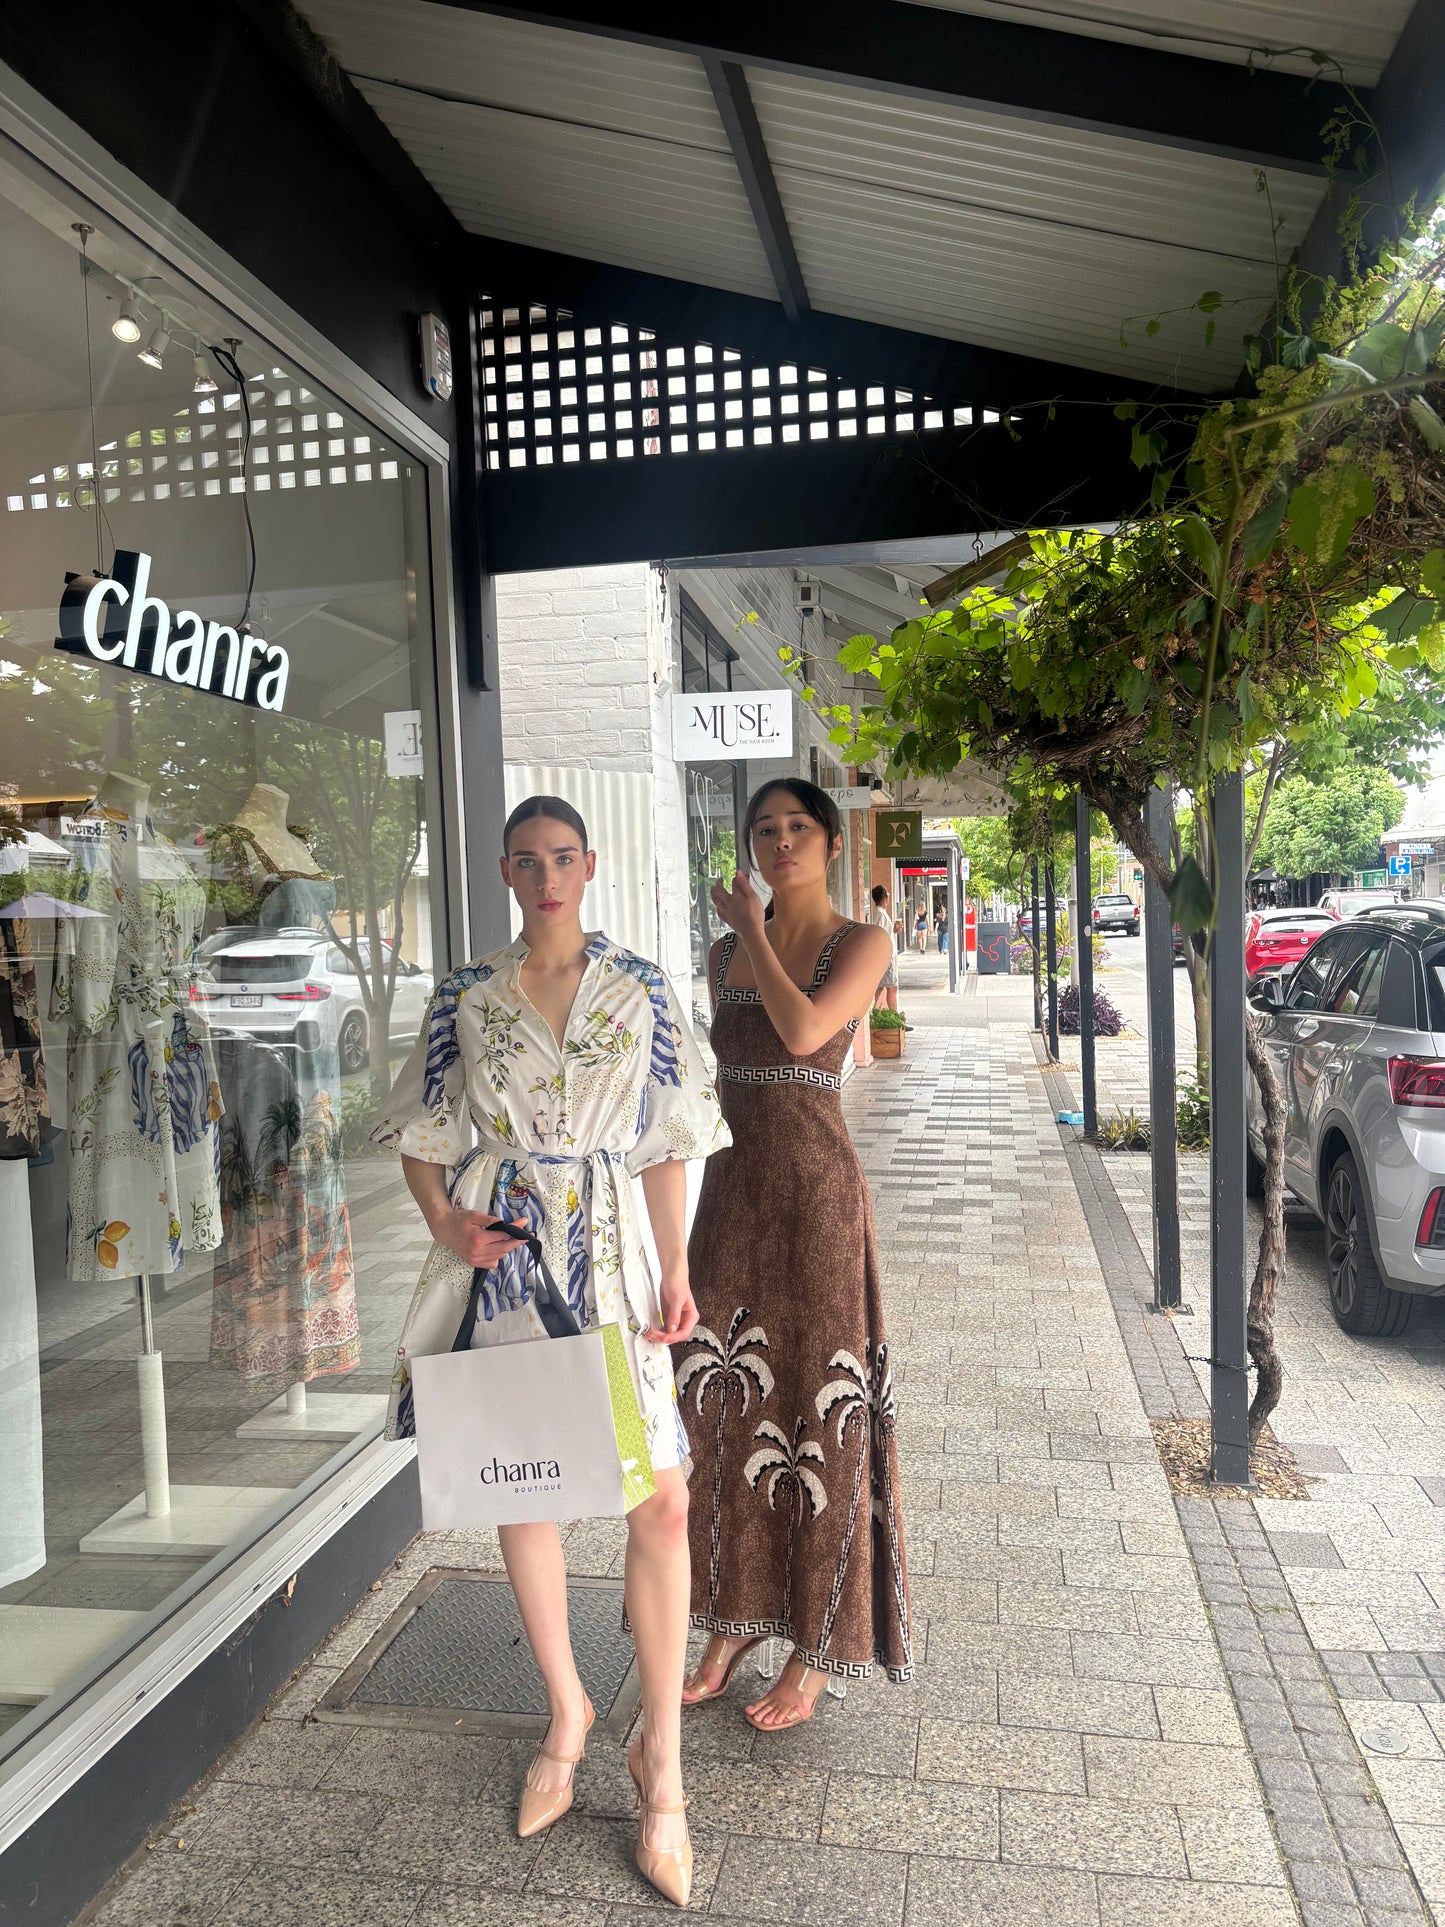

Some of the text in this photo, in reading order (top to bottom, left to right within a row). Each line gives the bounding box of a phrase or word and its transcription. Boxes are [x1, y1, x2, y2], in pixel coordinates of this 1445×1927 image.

[82, 552, 290, 712] chanra
[689, 703, 780, 747] MUSE.
[825, 788, 855, 804] epo
[888, 822, 912, 848] F
[1395, 857, 1407, 870] P
[480, 1457, 561, 1485] chanra
[515, 1484, 562, 1493] BOUTIQUE
[1376, 1733, 1394, 1749] K28
